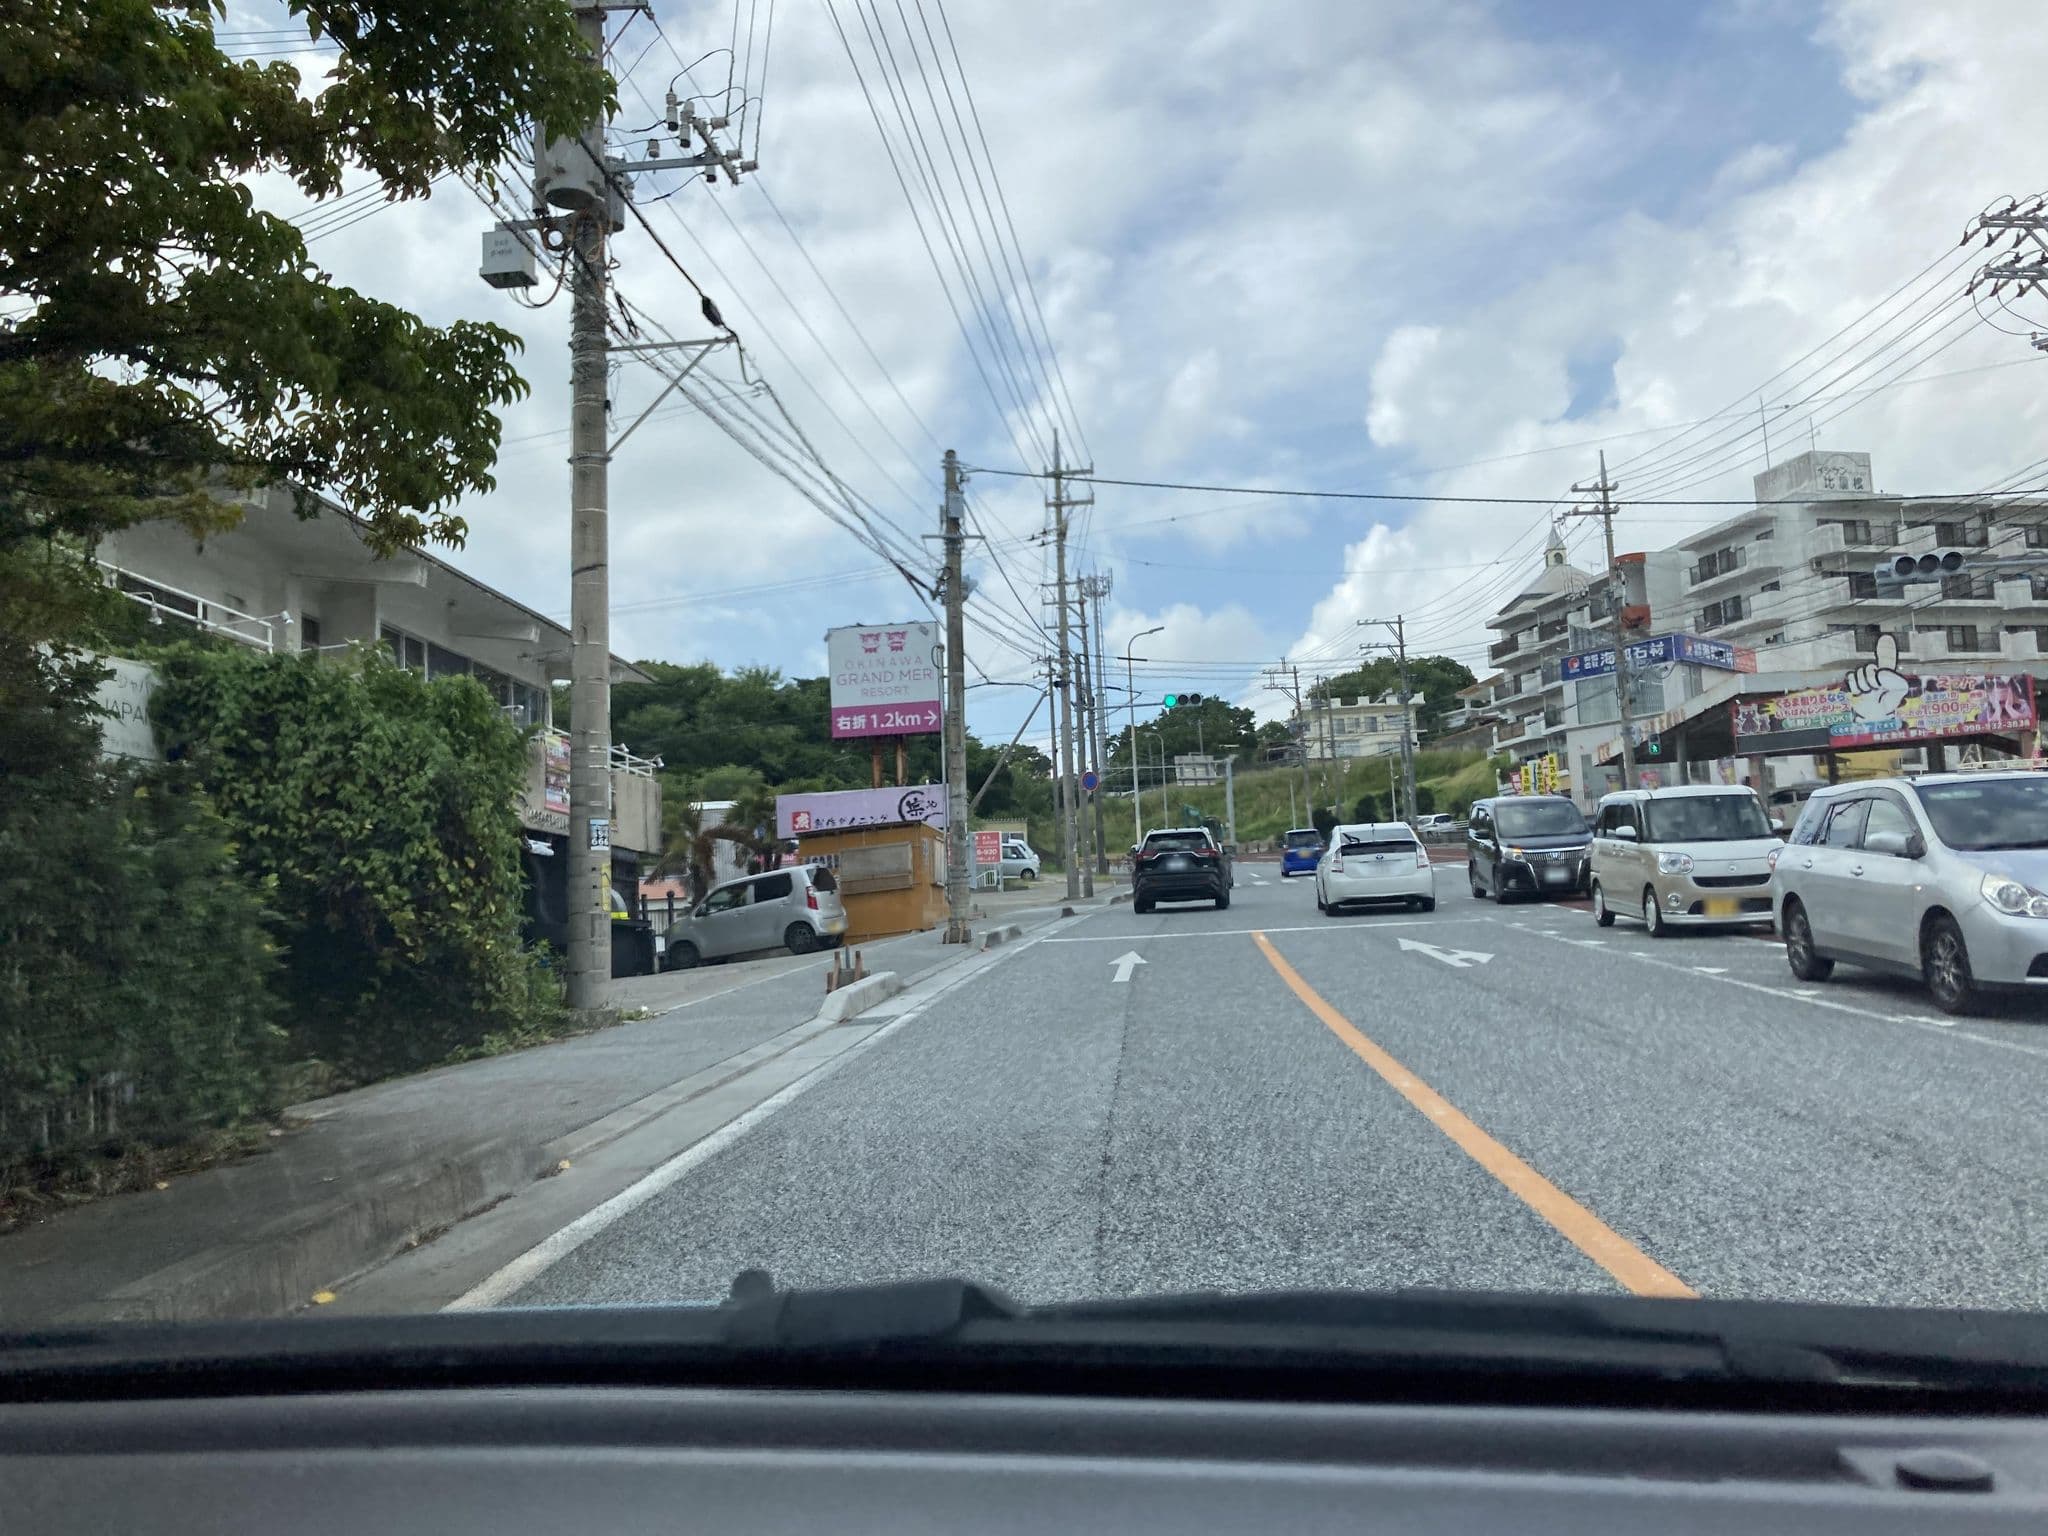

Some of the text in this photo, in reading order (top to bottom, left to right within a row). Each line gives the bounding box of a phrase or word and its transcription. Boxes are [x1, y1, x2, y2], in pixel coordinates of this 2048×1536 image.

[844, 656, 923, 670] OKINAWA
[836, 668, 934, 686] GRAND MER
[861, 686, 910, 697] RESORT
[836, 711, 921, 731] 右折 1.2km
